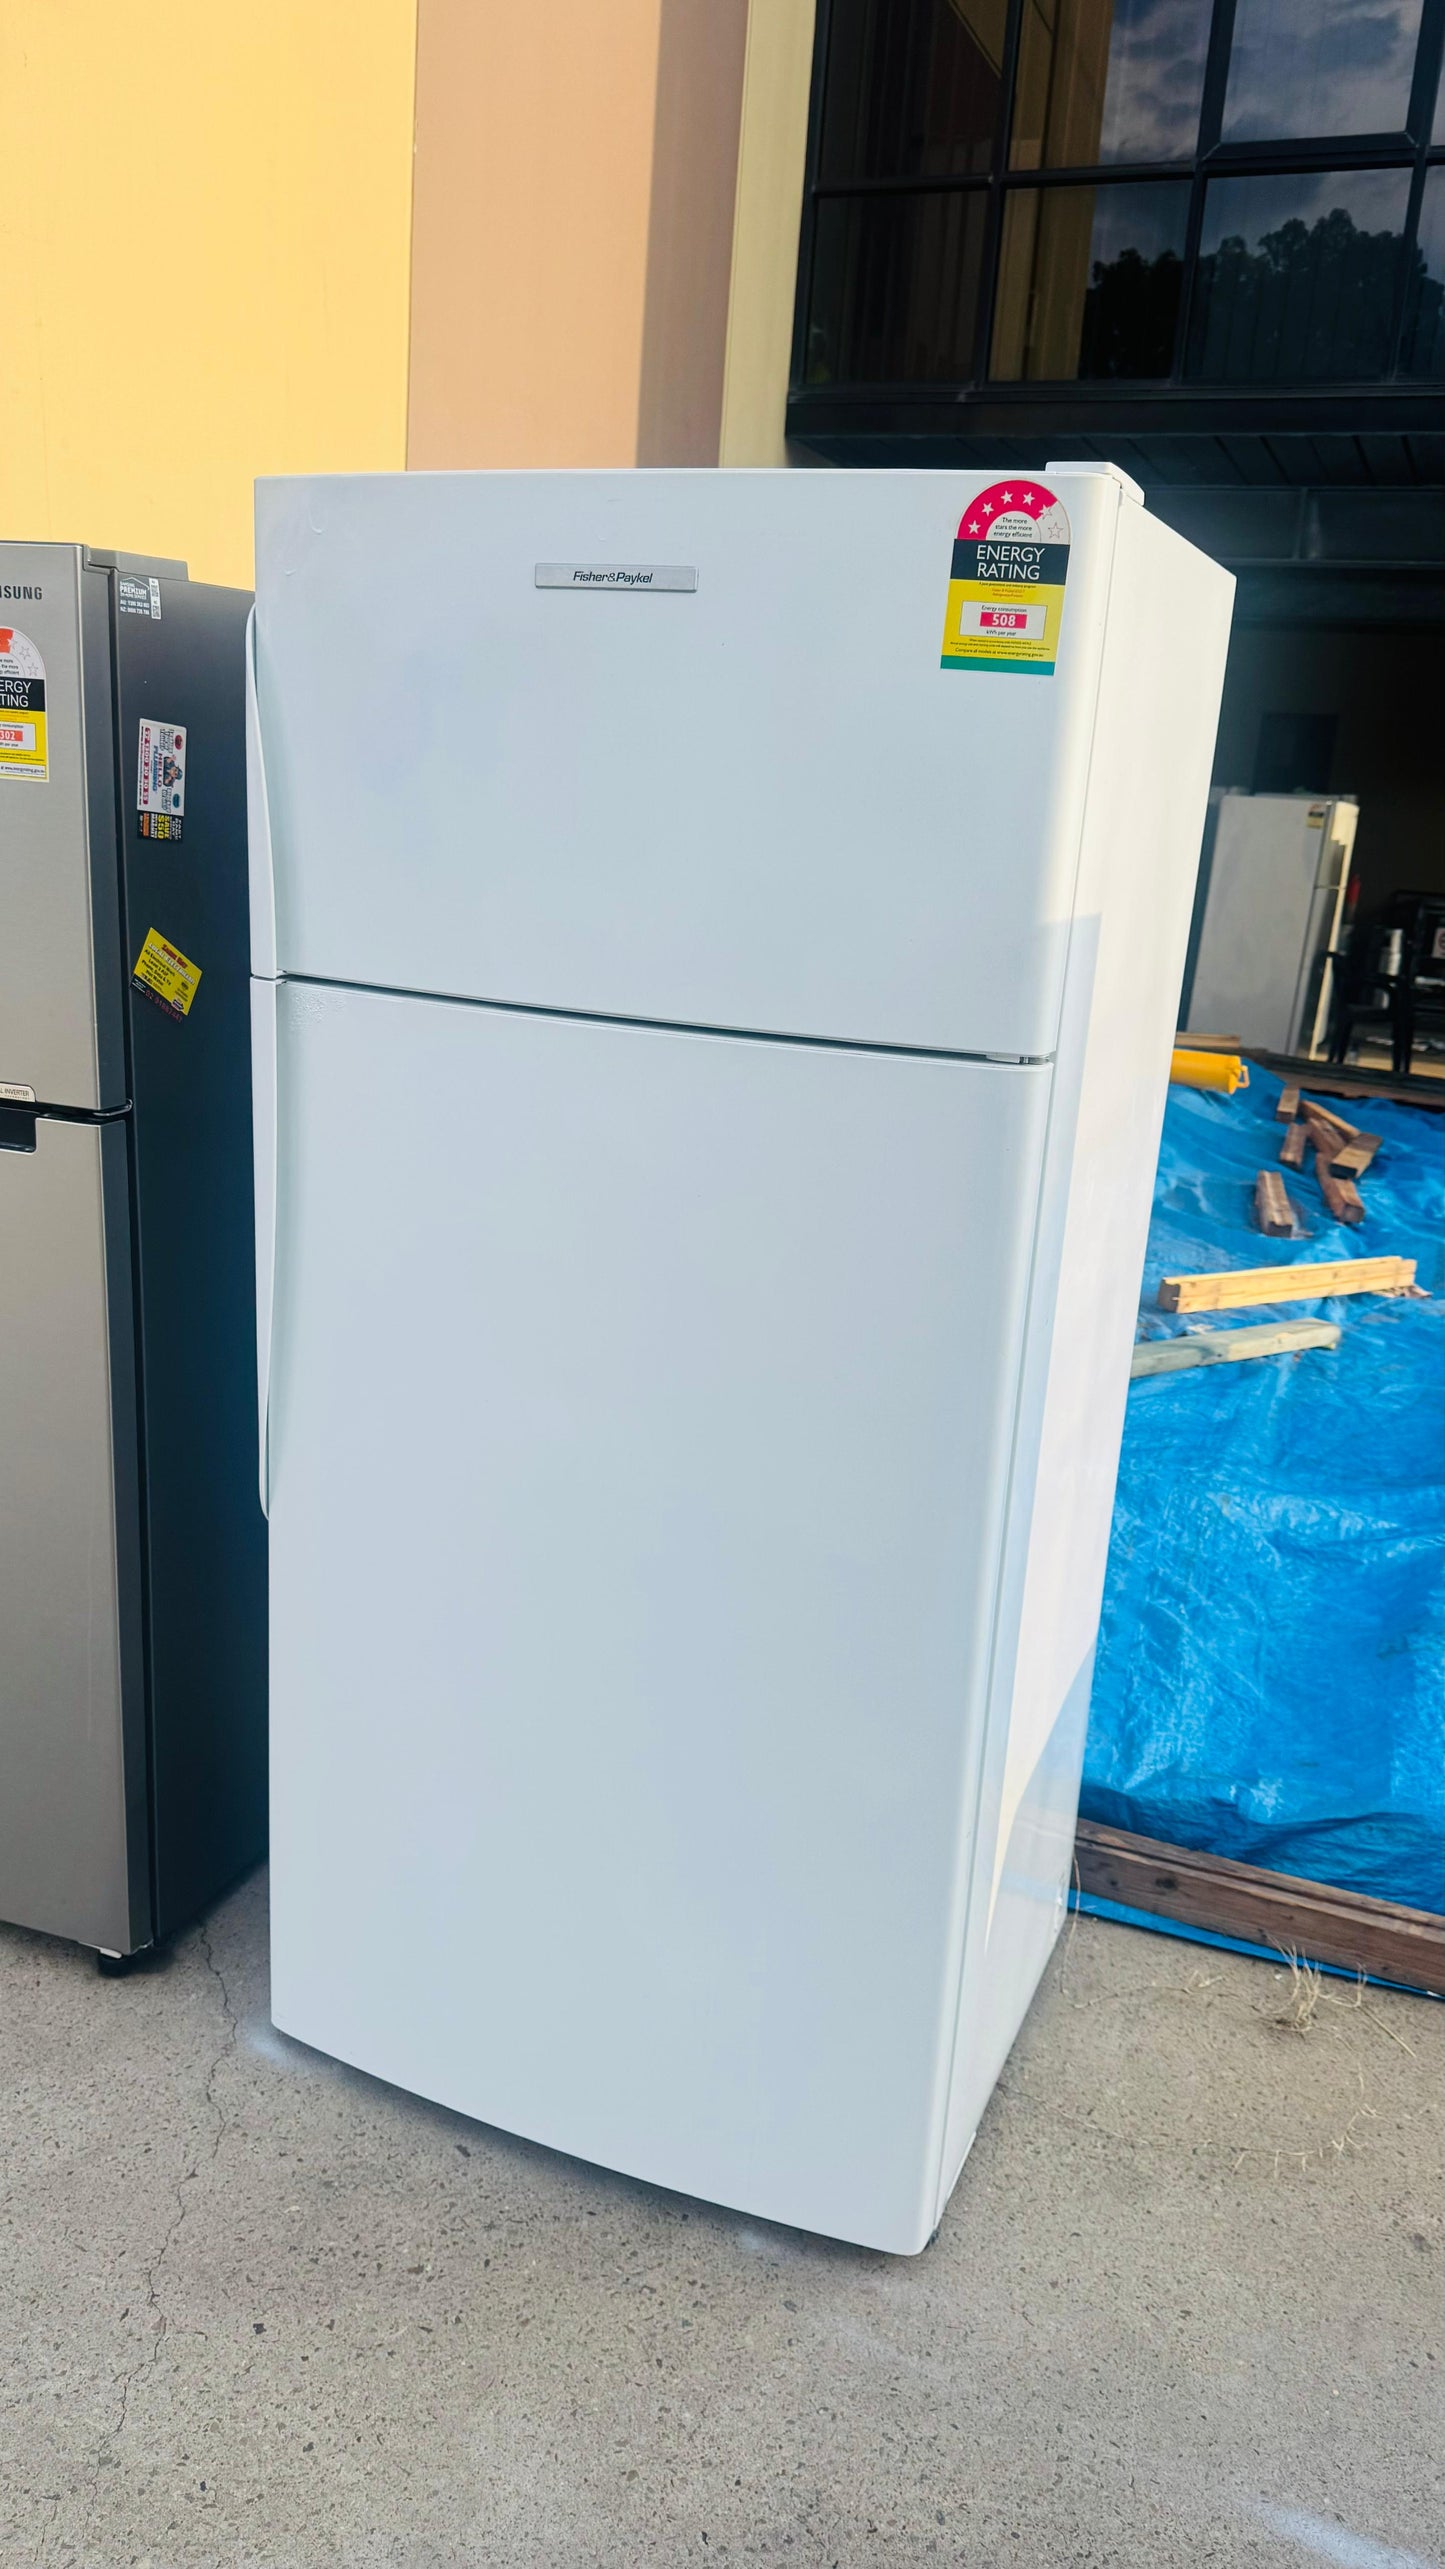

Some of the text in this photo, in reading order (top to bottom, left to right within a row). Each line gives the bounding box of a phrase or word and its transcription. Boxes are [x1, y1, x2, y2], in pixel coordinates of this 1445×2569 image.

[976, 544, 1045, 562] ENERGY
[572, 570, 654, 586] Fisher&Paykel
[977, 564, 1040, 580] RATING
[0, 585, 42, 600] SUNG
[992, 614, 1016, 626] 508
[0, 693, 29, 708] TING
